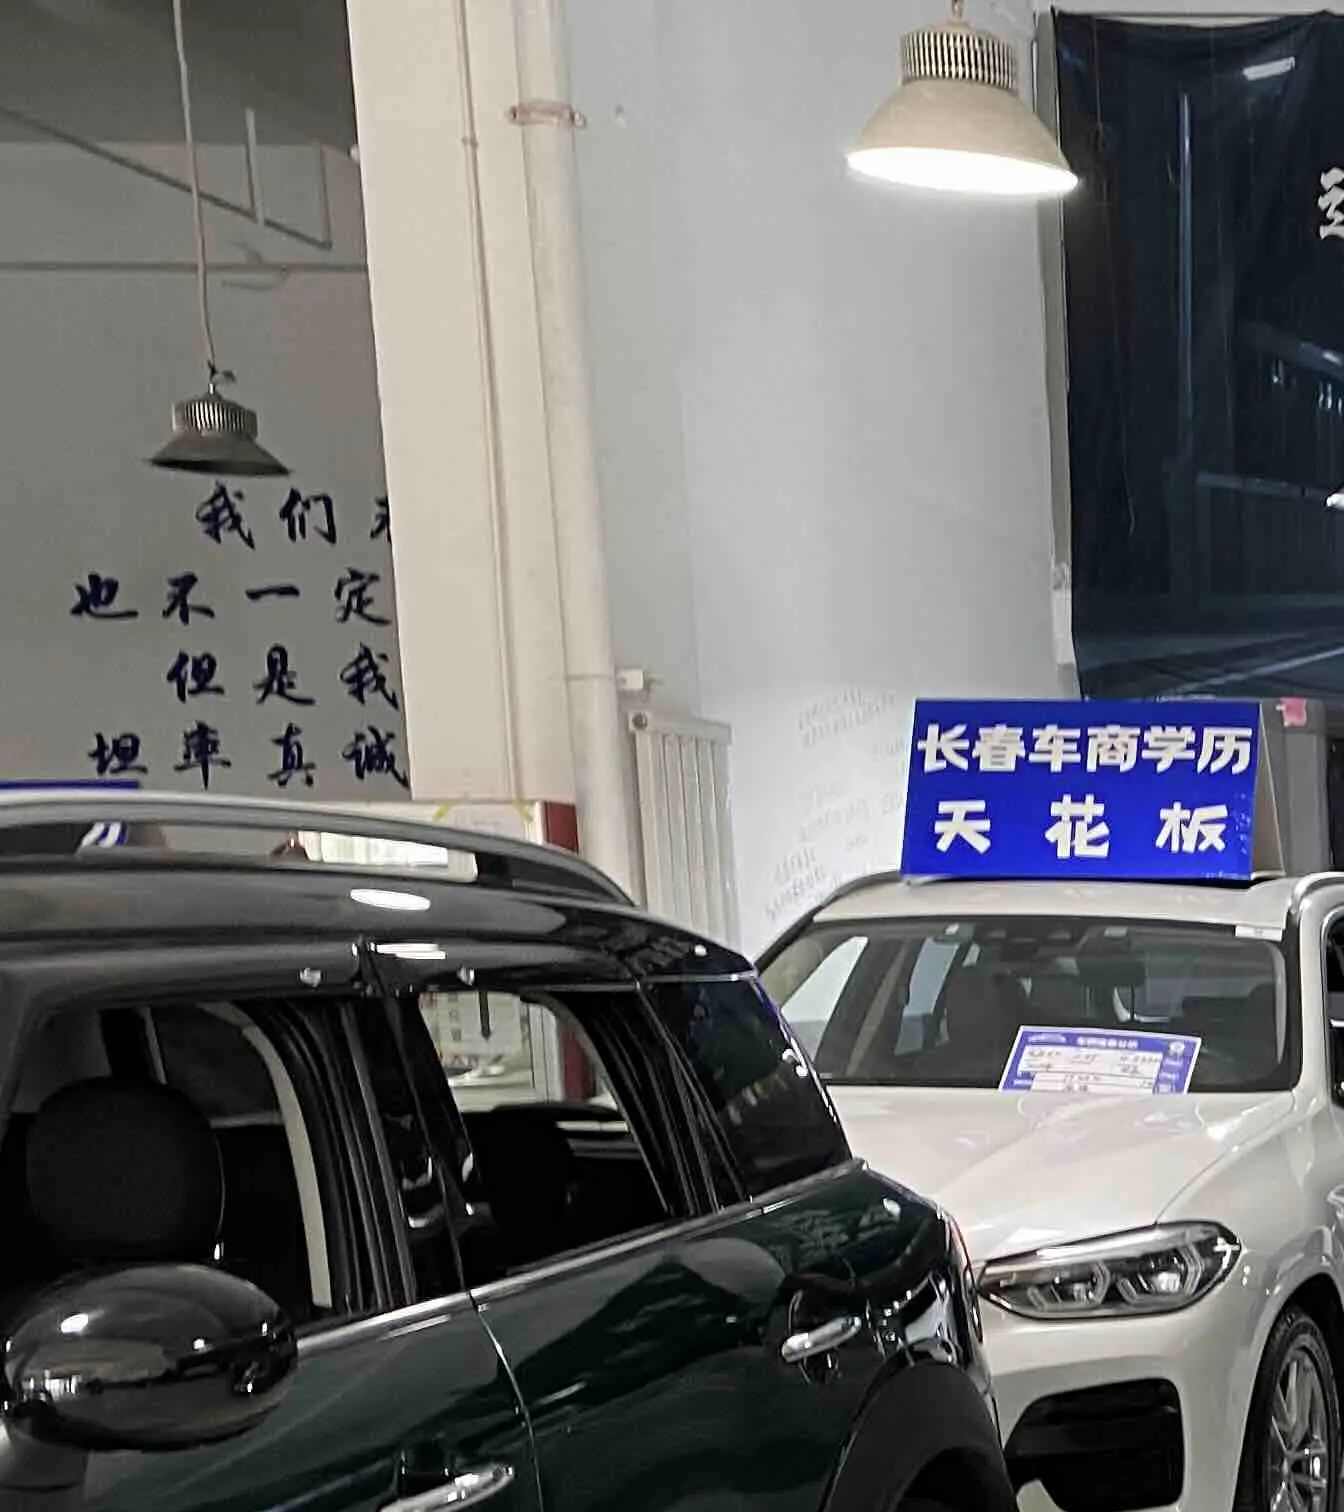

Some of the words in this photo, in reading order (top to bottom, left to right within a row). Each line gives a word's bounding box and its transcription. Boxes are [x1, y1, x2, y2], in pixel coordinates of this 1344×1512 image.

[70, 567, 392, 625] 也不一定
[166, 641, 400, 711] 但是我
[88, 720, 410, 791] 坦率真诚
[917, 723, 1253, 775] 长春车商学历
[934, 794, 1229, 860] 天花板
